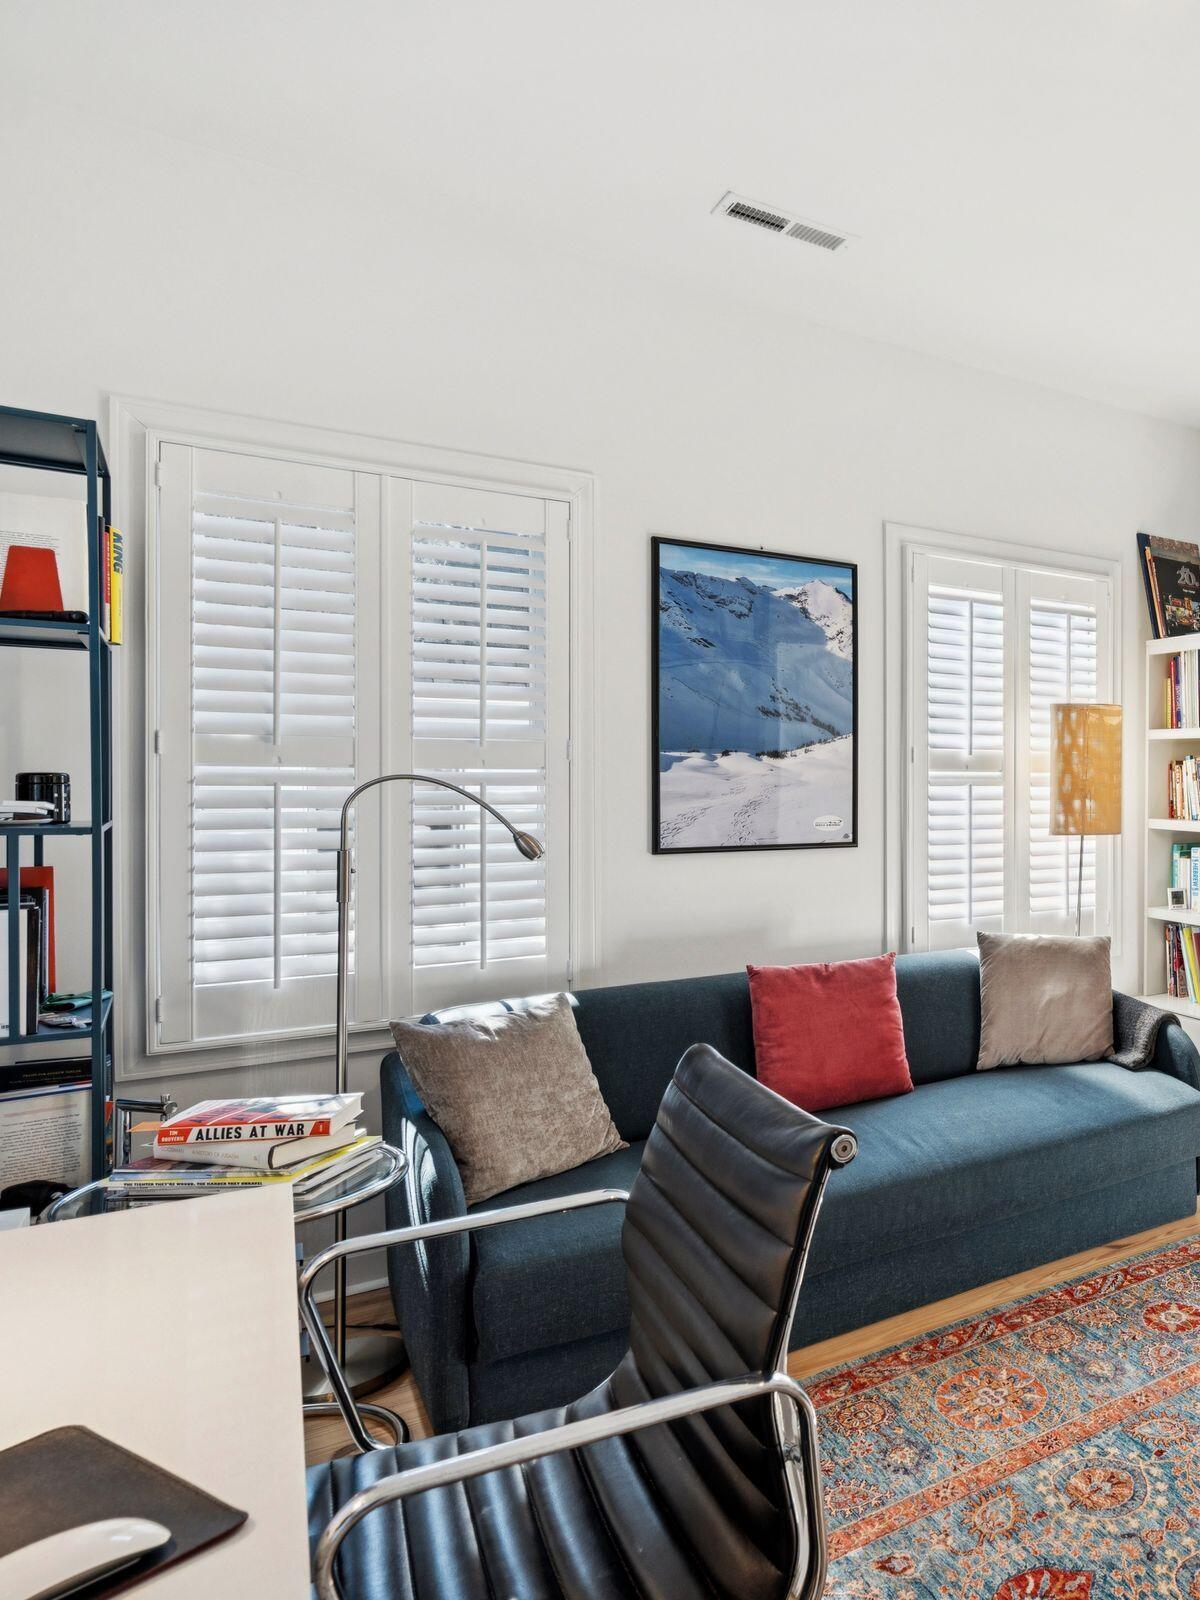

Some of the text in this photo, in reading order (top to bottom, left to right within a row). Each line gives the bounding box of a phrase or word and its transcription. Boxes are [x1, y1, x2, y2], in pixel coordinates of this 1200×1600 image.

[113, 532, 123, 574] KING
[195, 1123, 304, 1141] ALLIES AT WAR
